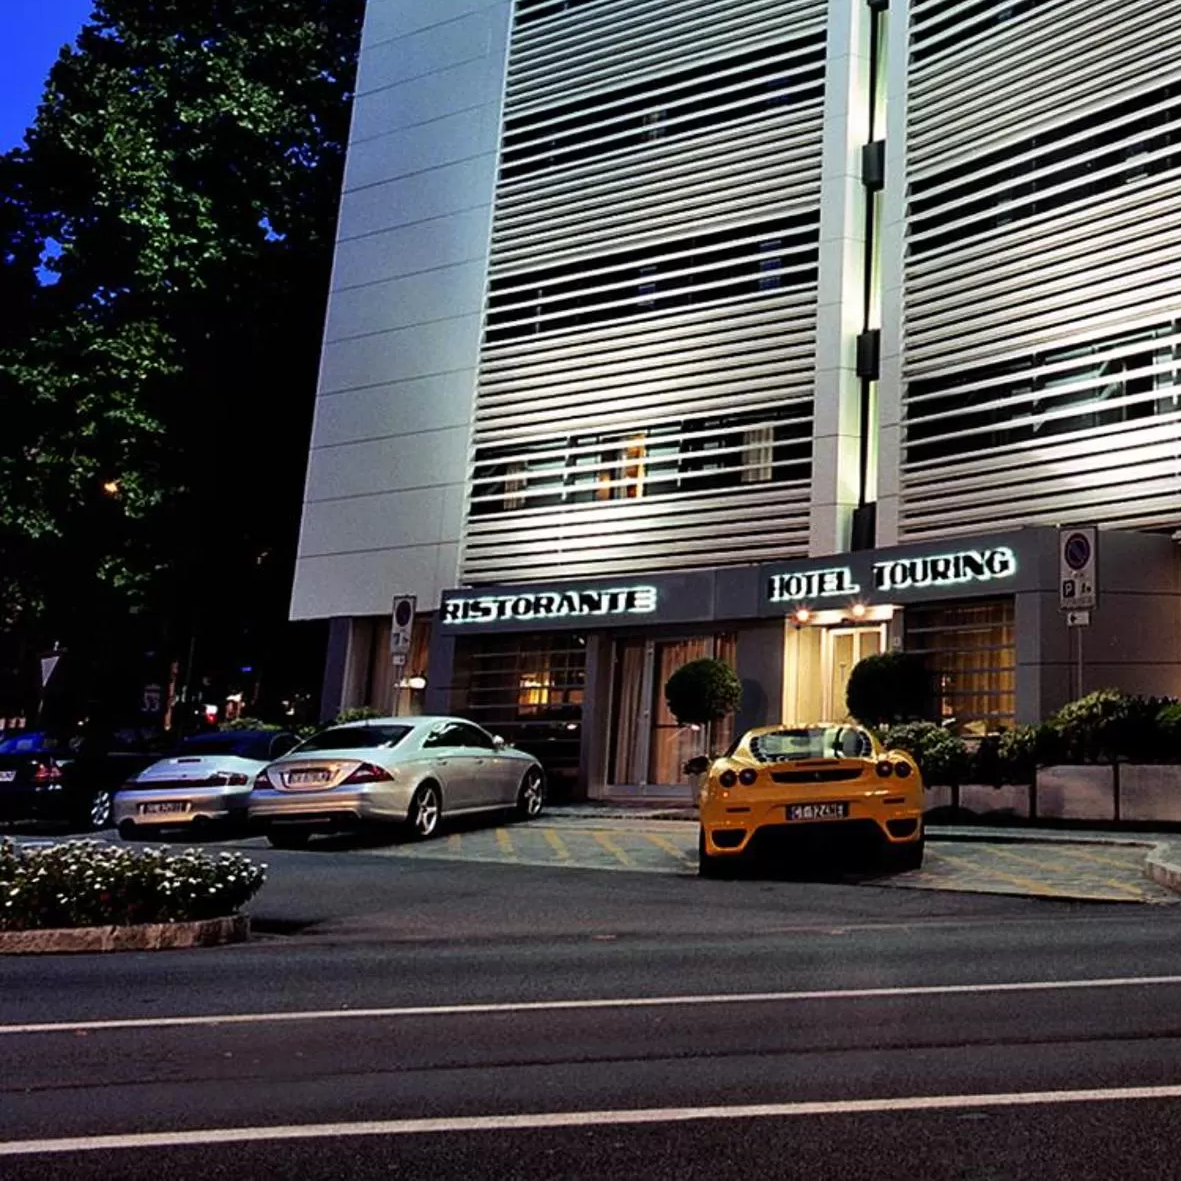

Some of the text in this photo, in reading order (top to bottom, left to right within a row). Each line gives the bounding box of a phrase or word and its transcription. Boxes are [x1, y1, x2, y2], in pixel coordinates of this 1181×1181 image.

[767, 547, 1016, 602] HOTEL TOURING
[440, 586, 657, 624] RISTORANTE
